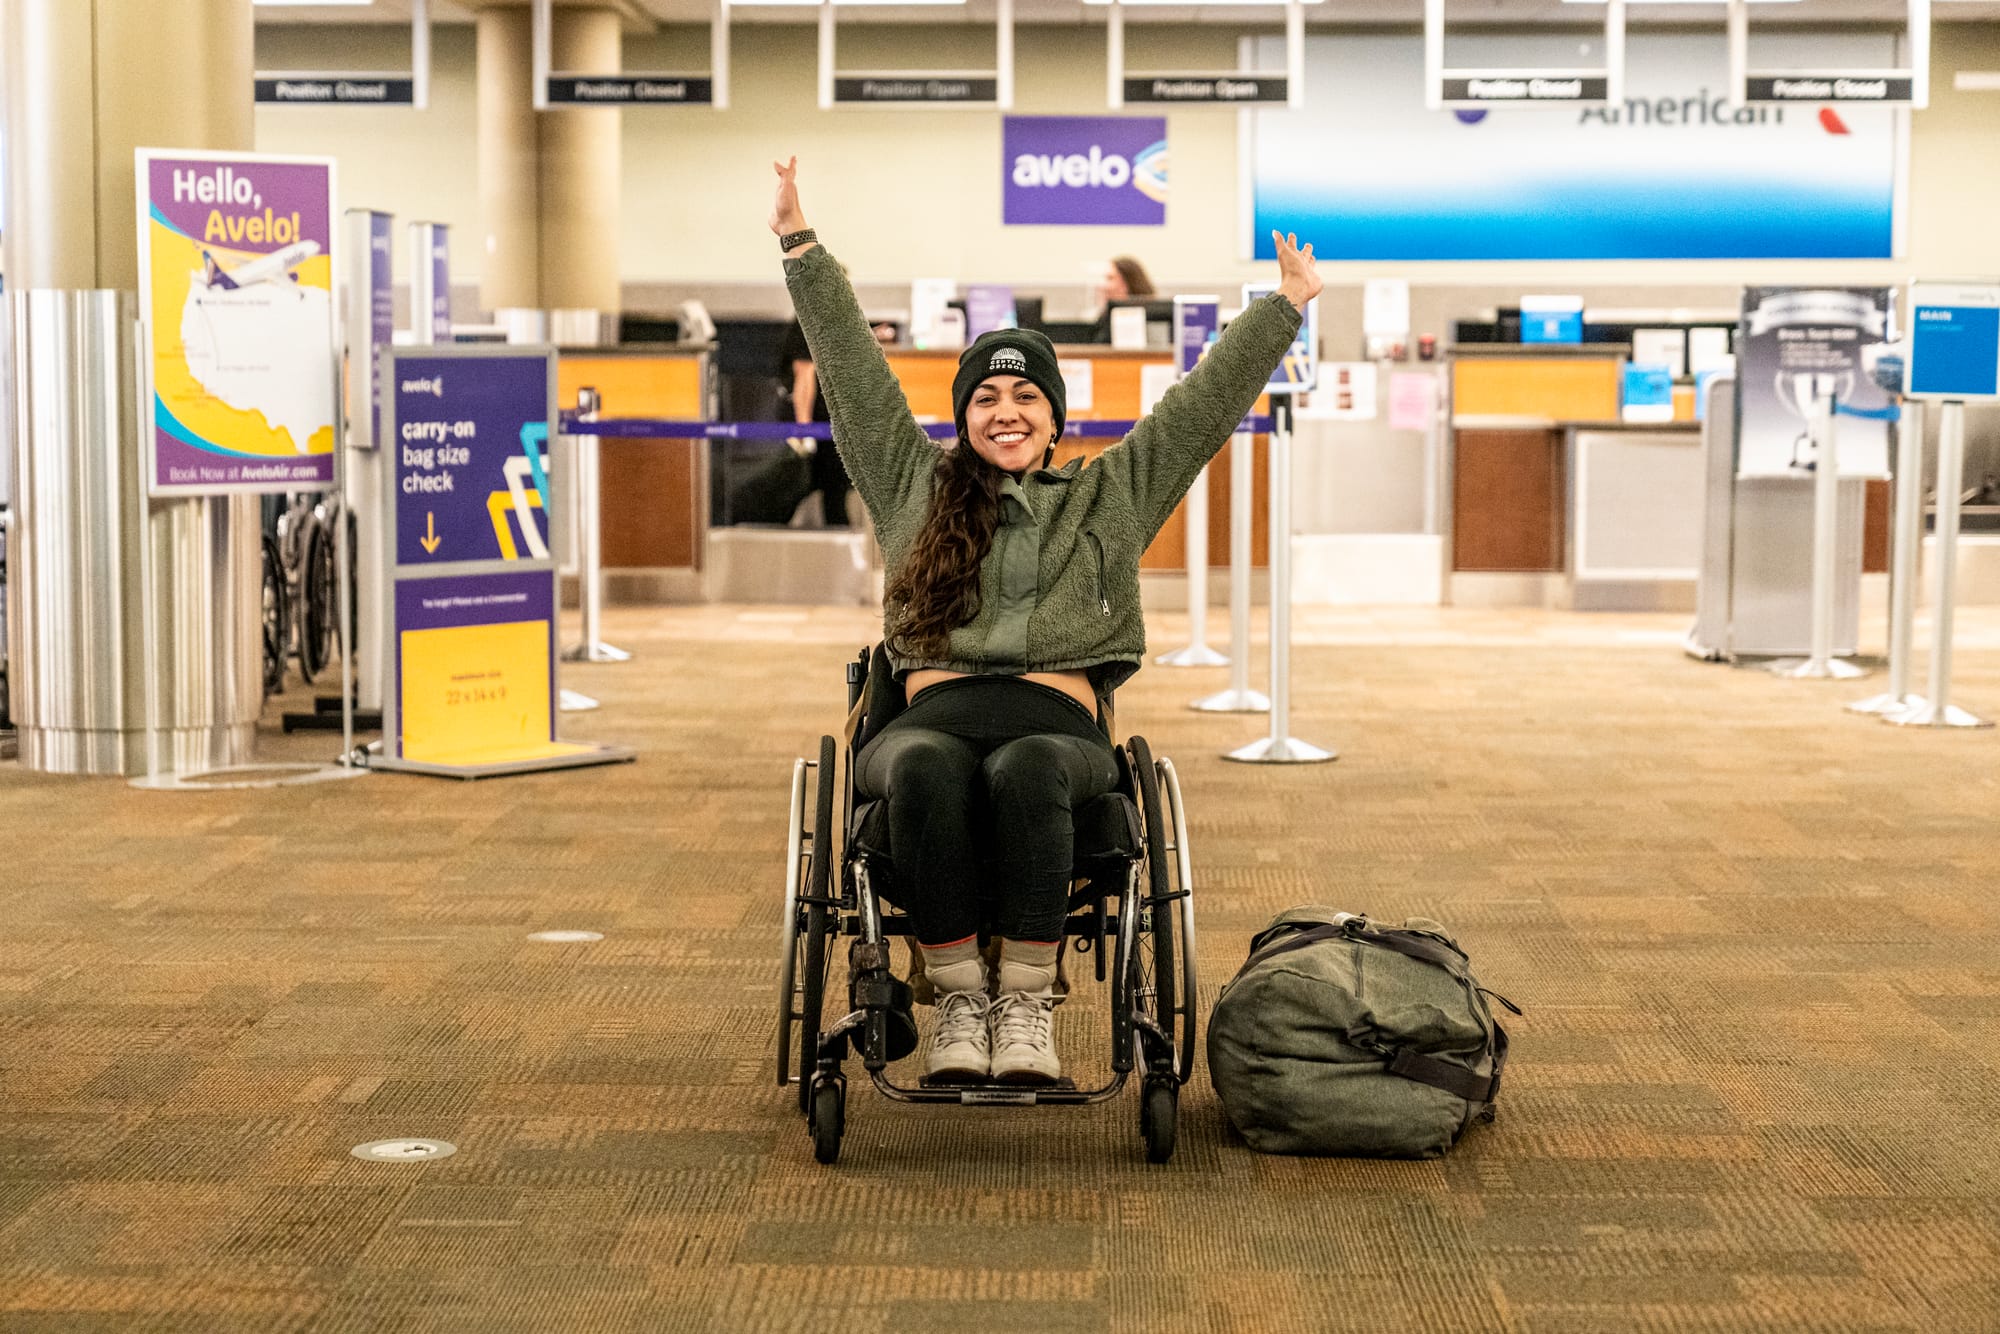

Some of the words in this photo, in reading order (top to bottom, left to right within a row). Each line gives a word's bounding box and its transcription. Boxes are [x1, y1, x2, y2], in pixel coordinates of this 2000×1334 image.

[276, 81, 333, 99] Position
[335, 81, 387, 99] Closed
[575, 81, 632, 98] Position
[634, 81, 686, 98] Closed
[862, 80, 922, 97] Position
[926, 80, 970, 98] Open
[1152, 79, 1214, 98] Position
[1215, 79, 1258, 98] Open
[1468, 79, 1528, 98] Position
[1528, 79, 1581, 98] Closed
[1773, 79, 1831, 98] Position
[1833, 79, 1887, 98] Closed
[1012, 145, 1130, 188] avelo
[173, 166, 262, 210] Hello,
[204, 207, 300, 244] Avelo!
[989, 364, 1026, 372] OREGON
[402, 377, 432, 393] avelo
[402, 421, 476, 443] carry-on
[403, 444, 434, 470] bag
[437, 443, 470, 465] size
[169, 466, 198, 482] Book
[200, 465, 225, 481] Now
[227, 465, 240, 480] at
[241, 463, 319, 480] AveloAir.com
[403, 470, 454, 494] check
